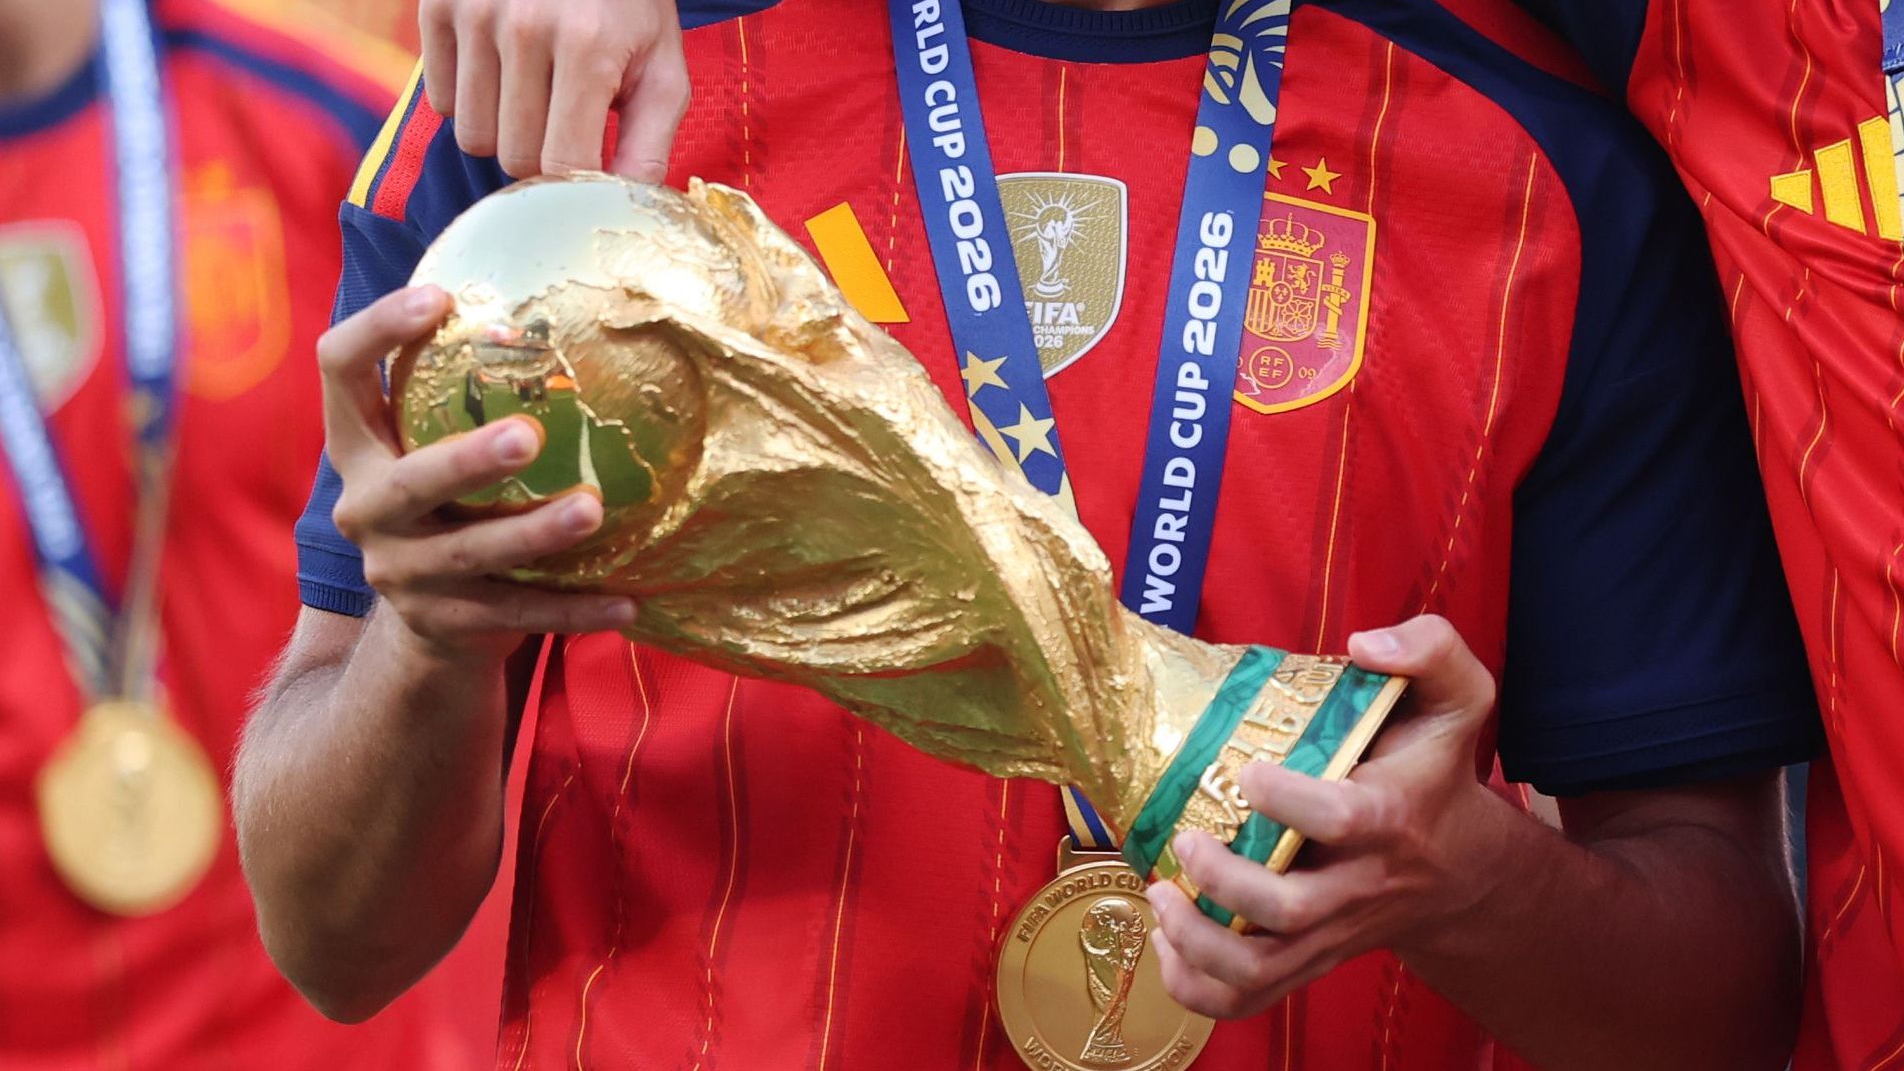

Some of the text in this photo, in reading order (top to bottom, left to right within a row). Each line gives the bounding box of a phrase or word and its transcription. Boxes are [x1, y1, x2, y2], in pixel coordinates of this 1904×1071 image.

[924, 80, 966, 159] CUP
[939, 165, 1002, 313] 2026
[1033, 325, 1095, 335] CHAMPIONS
[1034, 335, 1063, 348] 026
[1140, 211, 1235, 614] WORLD CUP 2026
[1017, 903, 1050, 942] FIFA
[1045, 872, 1112, 907] WORLD
